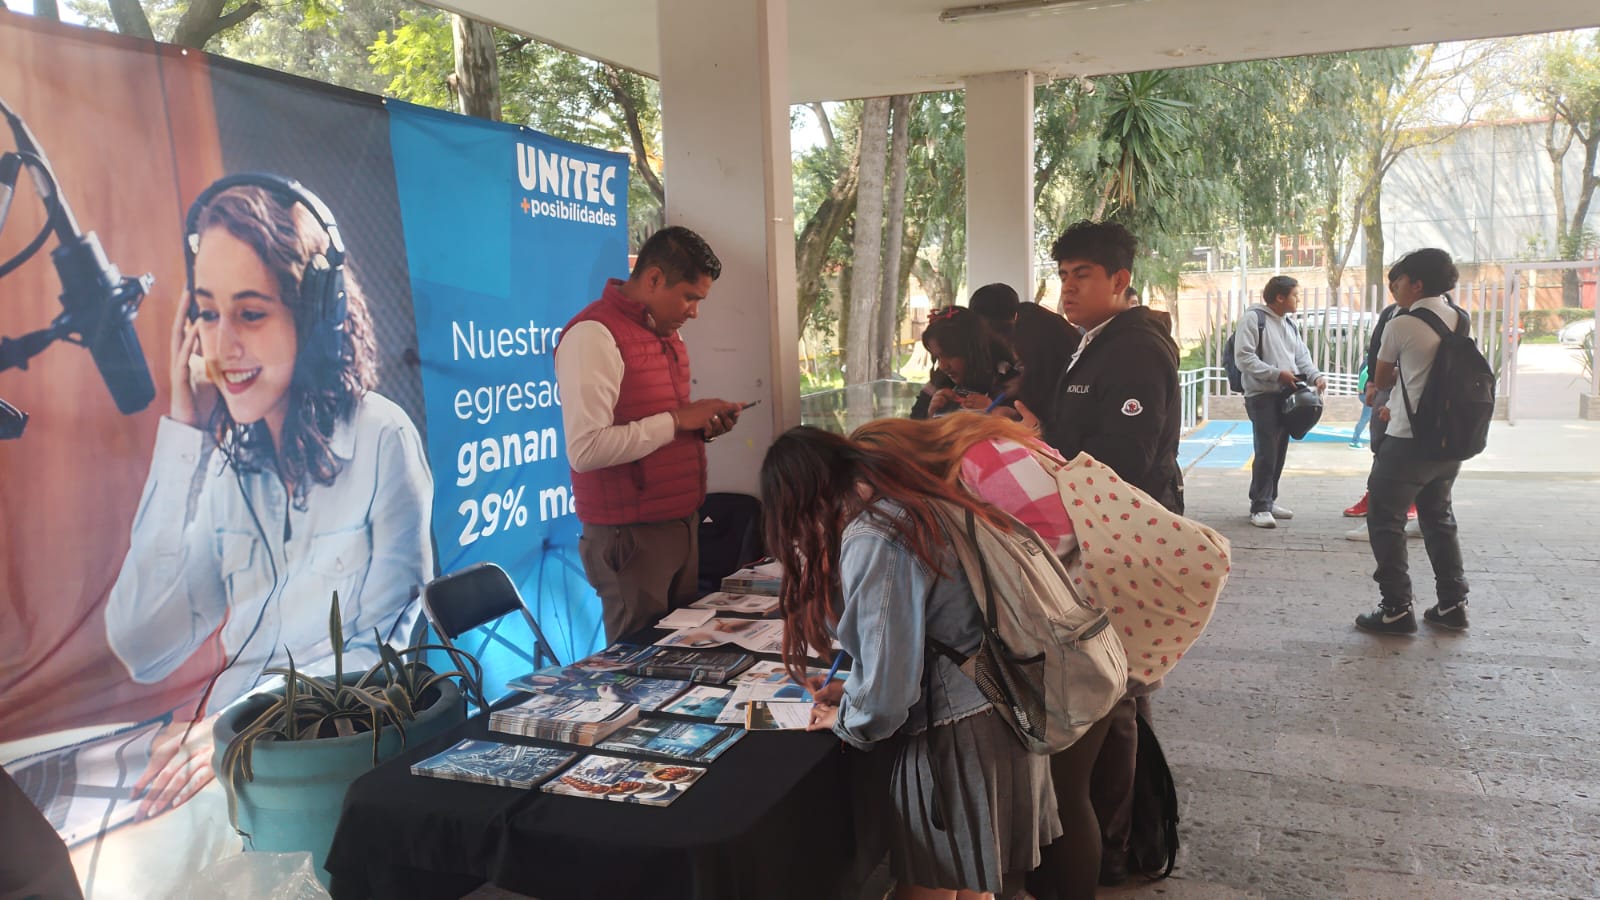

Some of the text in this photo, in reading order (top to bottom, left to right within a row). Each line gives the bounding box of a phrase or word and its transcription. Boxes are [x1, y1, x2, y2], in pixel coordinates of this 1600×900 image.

[516, 142, 616, 206] UNITEC
[456, 427, 558, 487] ganan
[457, 485, 528, 547] 29%
